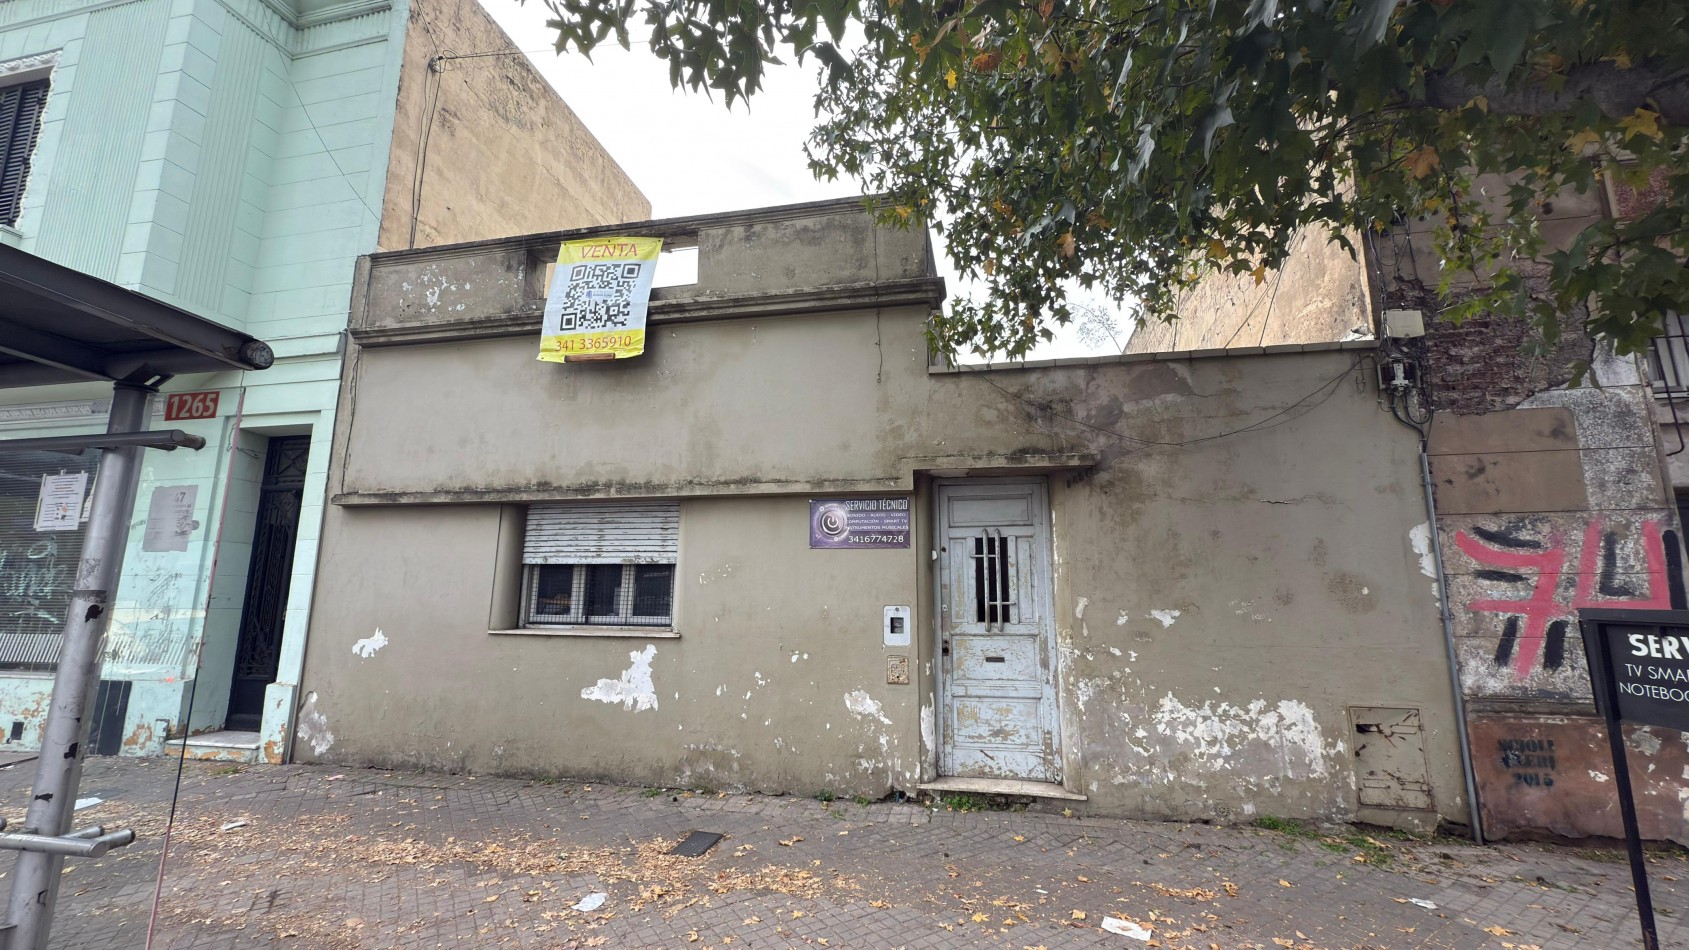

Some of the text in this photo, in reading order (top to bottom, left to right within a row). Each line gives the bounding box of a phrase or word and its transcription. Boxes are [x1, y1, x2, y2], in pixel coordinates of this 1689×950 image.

[581, 243, 638, 258] VENTA
[555, 335, 632, 352] 341 3365910
[171, 393, 217, 418] 1265
[845, 498, 908, 510] SERVICIO TÉCNICO
[848, 535, 904, 543] 3416774728
[1625, 663, 1689, 682] TV SMA
